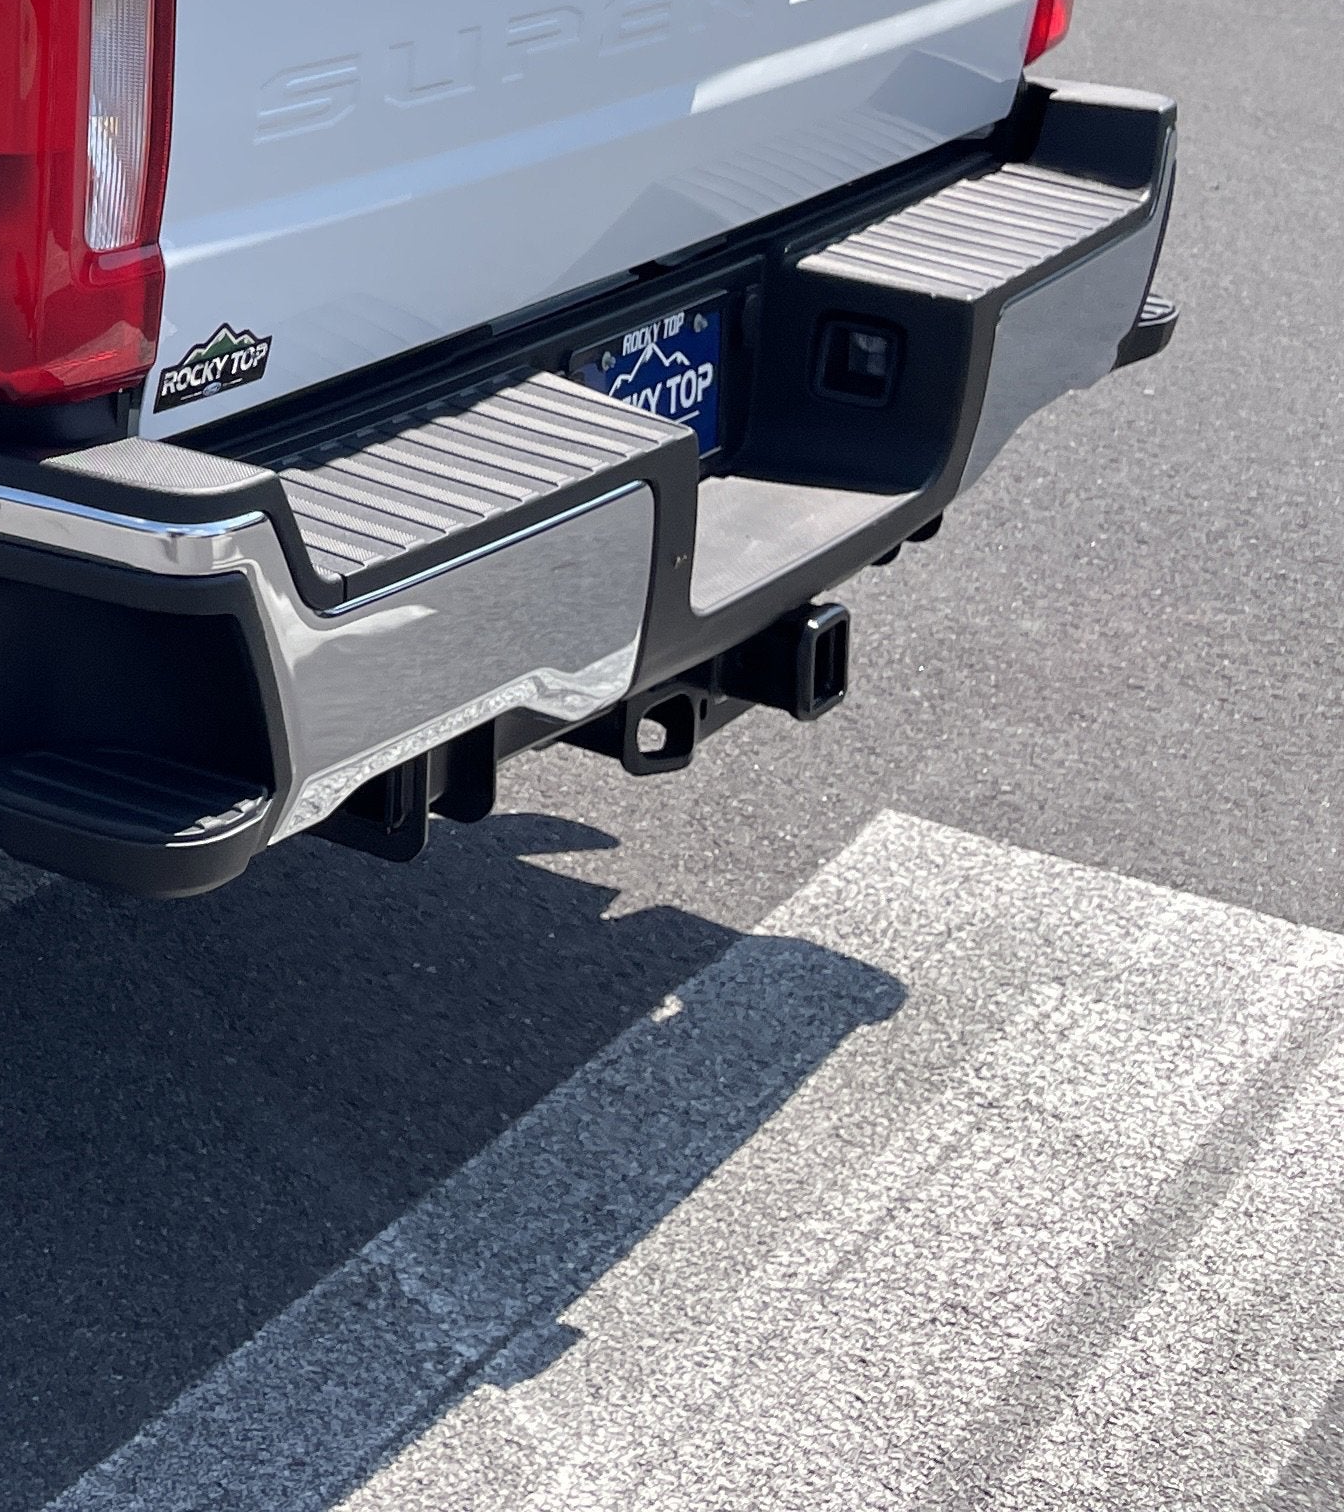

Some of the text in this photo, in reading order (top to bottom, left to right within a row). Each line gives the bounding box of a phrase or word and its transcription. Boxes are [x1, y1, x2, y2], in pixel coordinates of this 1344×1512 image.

[622, 311, 686, 357] ROCKY TOP
[161, 342, 269, 397] ROCKY TOP
[665, 362, 714, 415] TOP
